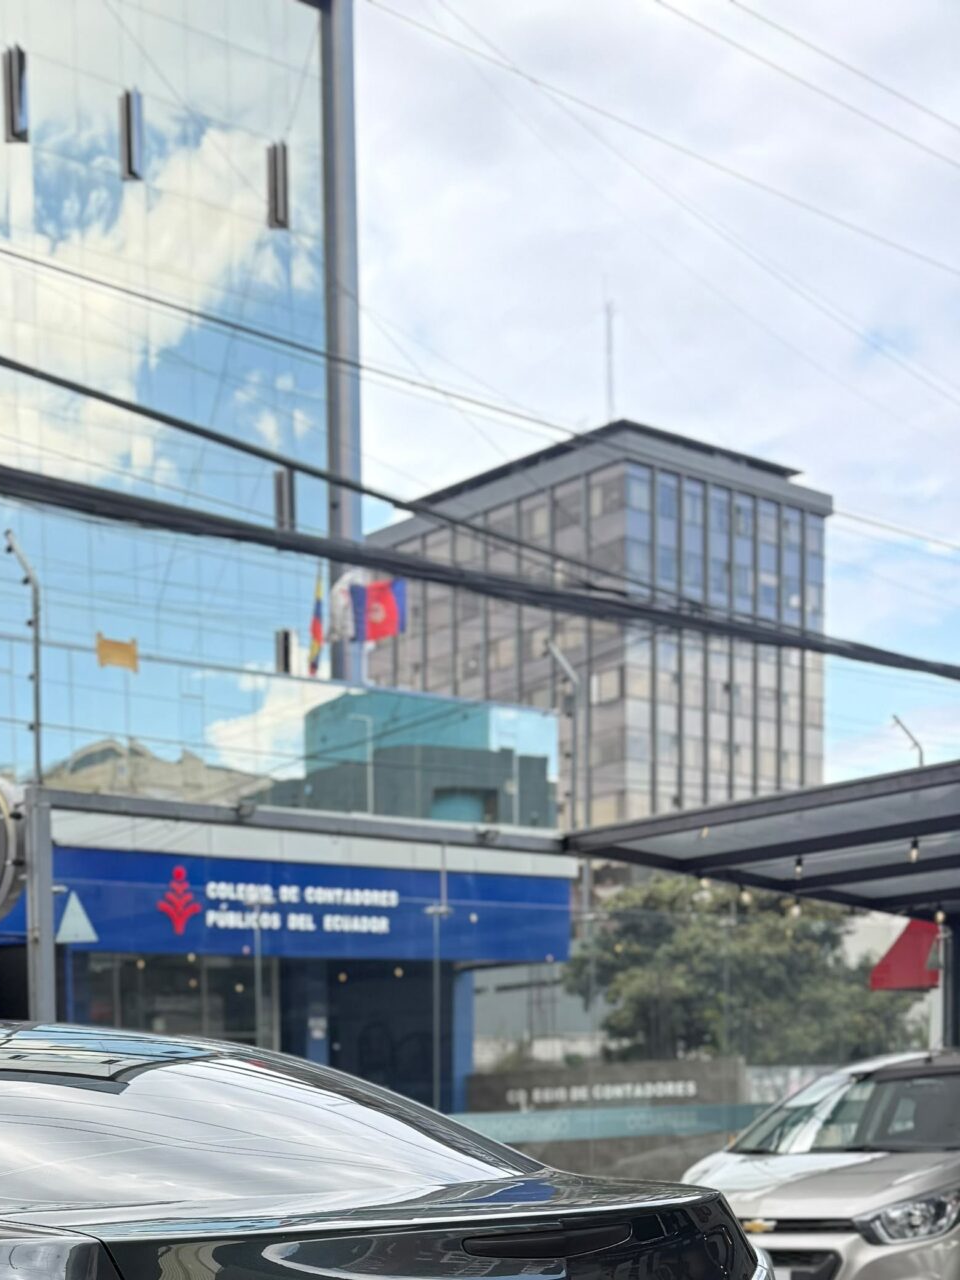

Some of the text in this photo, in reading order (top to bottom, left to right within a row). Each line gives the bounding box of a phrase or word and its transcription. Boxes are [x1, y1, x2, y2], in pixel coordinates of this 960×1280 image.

[205, 881, 399, 908] COLEGIO DE CONTADORES
[205, 902, 390, 934] PÚBLICOS DEL ECUADOR
[505, 1086, 568, 1104] COEGIO
[592, 1080, 697, 1100] CONTADORES
